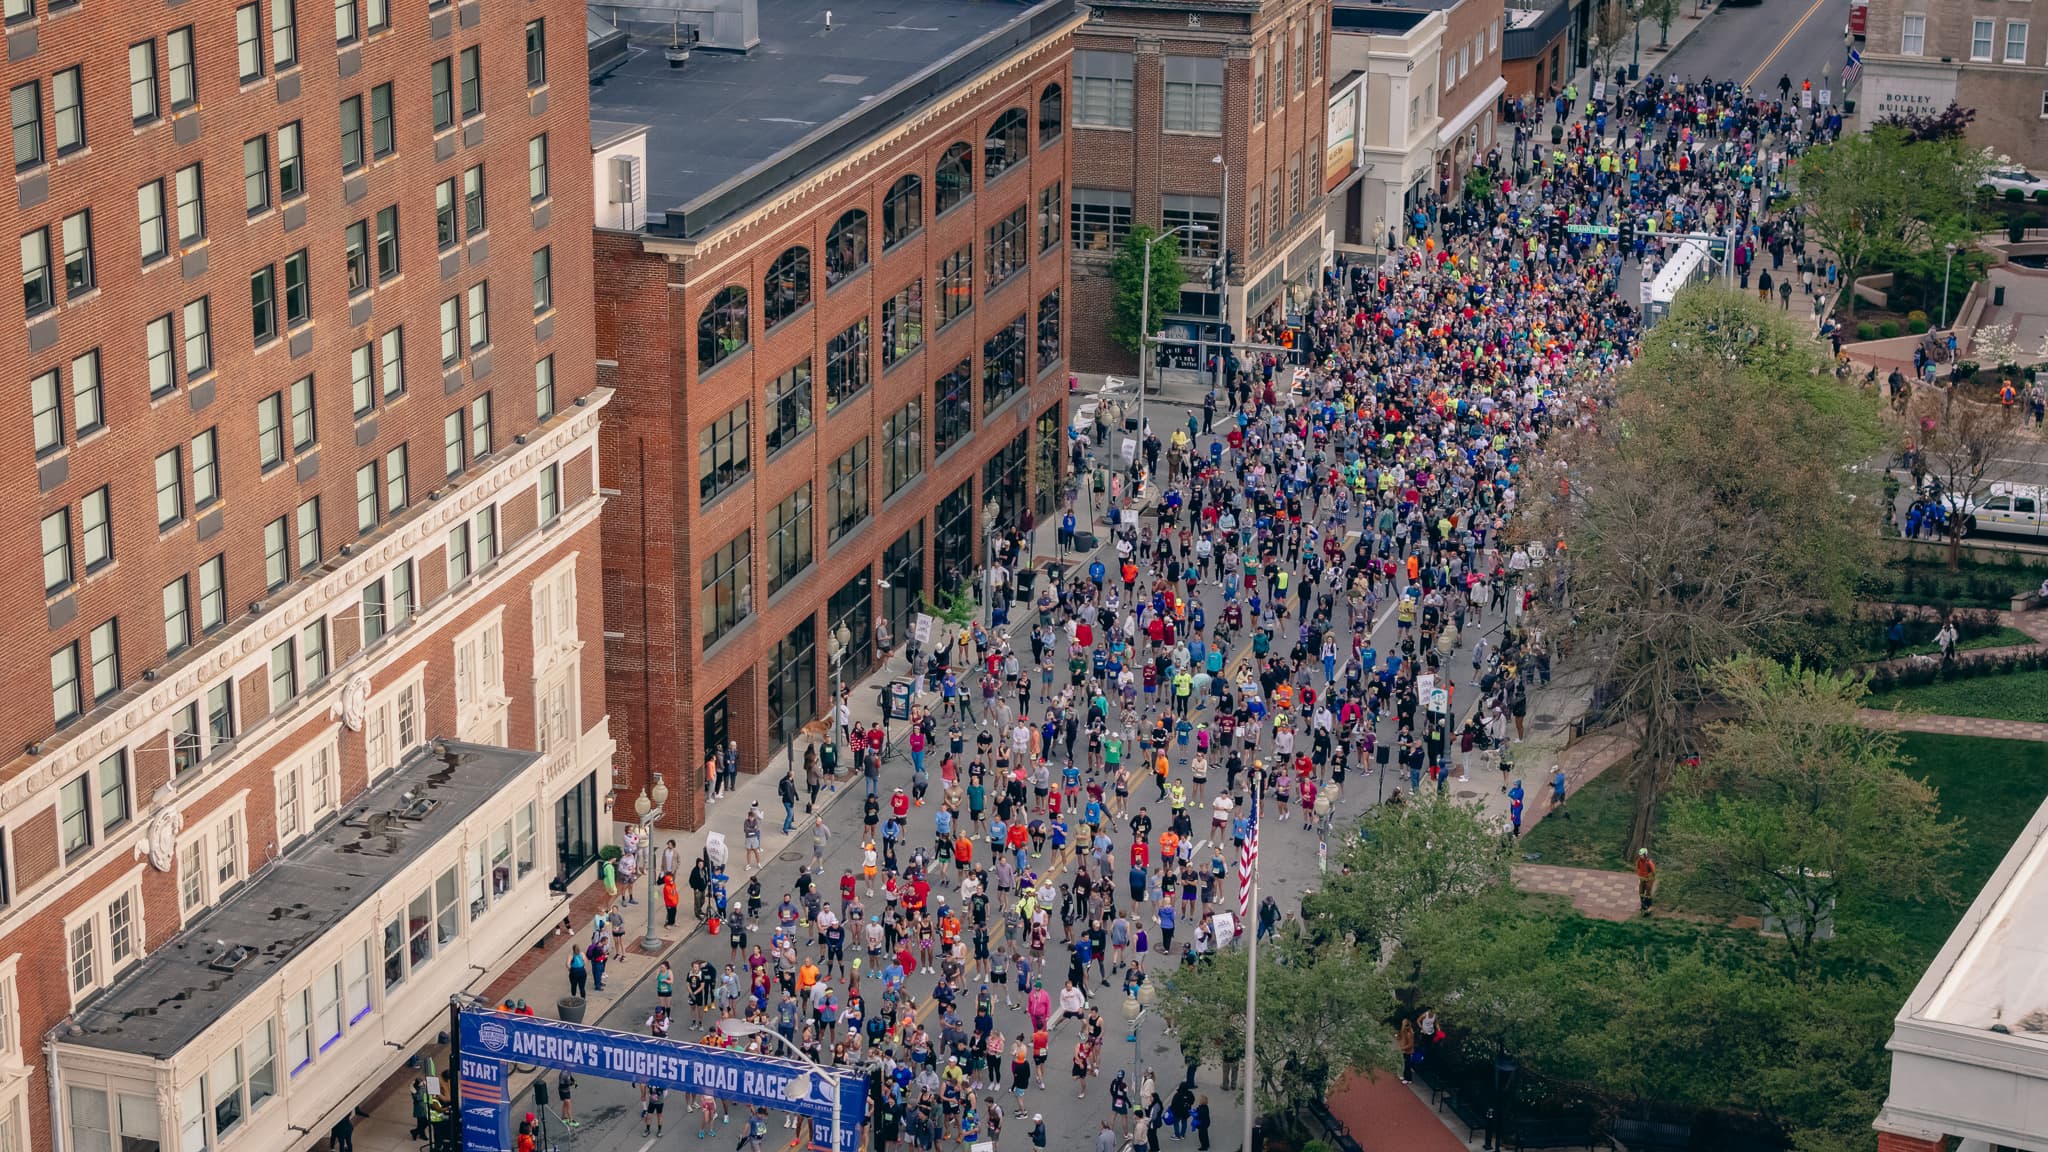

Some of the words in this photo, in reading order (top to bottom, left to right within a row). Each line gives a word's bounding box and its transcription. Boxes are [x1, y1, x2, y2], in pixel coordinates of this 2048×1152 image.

[1886, 94, 1931, 103] BOXLEY
[1879, 103, 1937, 114] BUILDING
[1568, 224, 1600, 233] FRANKLIN
[512, 1031, 598, 1067] AMERICA'S
[603, 1046, 689, 1082] TOUGHEST
[693, 1061, 738, 1092] ROAD
[462, 1060, 498, 1081] START
